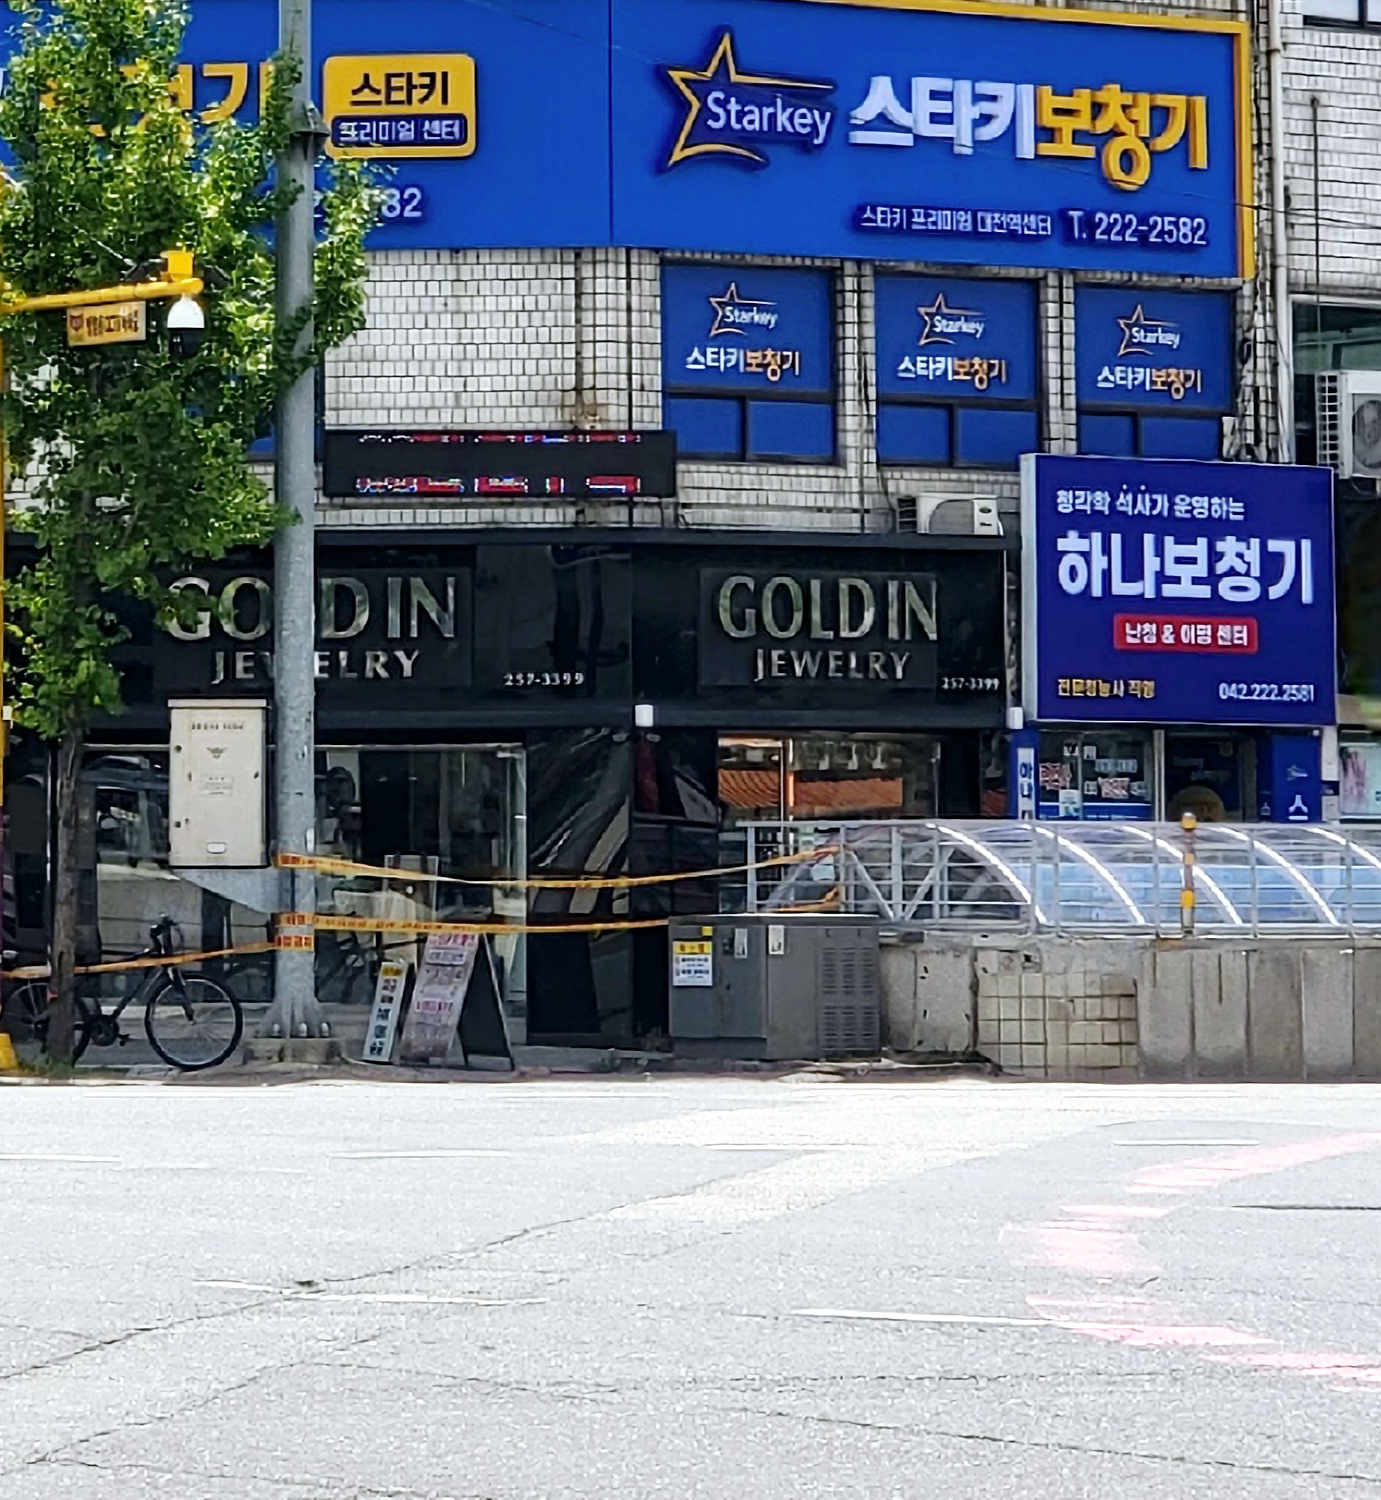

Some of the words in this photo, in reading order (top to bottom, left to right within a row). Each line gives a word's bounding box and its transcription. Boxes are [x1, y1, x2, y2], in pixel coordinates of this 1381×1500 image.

[349, 70, 449, 107] 스타키
[423, 121, 460, 142] 센터
[705, 90, 832, 147] Starkey
[848, 75, 1210, 192] 스타키보청기
[860, 205, 908, 231] 스타키
[911, 207, 973, 232] 프리미엄
[1094, 212, 1208, 246] 222-2582
[932, 313, 986, 340] Starkey
[1130, 324, 1181, 351] Starkey
[684, 346, 800, 382] 스타키보청기
[896, 353, 1007, 390] 스타키보청기
[1096, 366, 1202, 401] 스타키보청기
[1173, 494, 1245, 521] 운영하는
[1056, 529, 1314, 604] 하나보청기
[1124, 622, 1157, 644] 난청
[1217, 624, 1248, 646] 센터
[212, 649, 421, 685] JEELRY
[753, 648, 911, 682] JEWELRY
[1218, 682, 1315, 703] 042.222.2581
